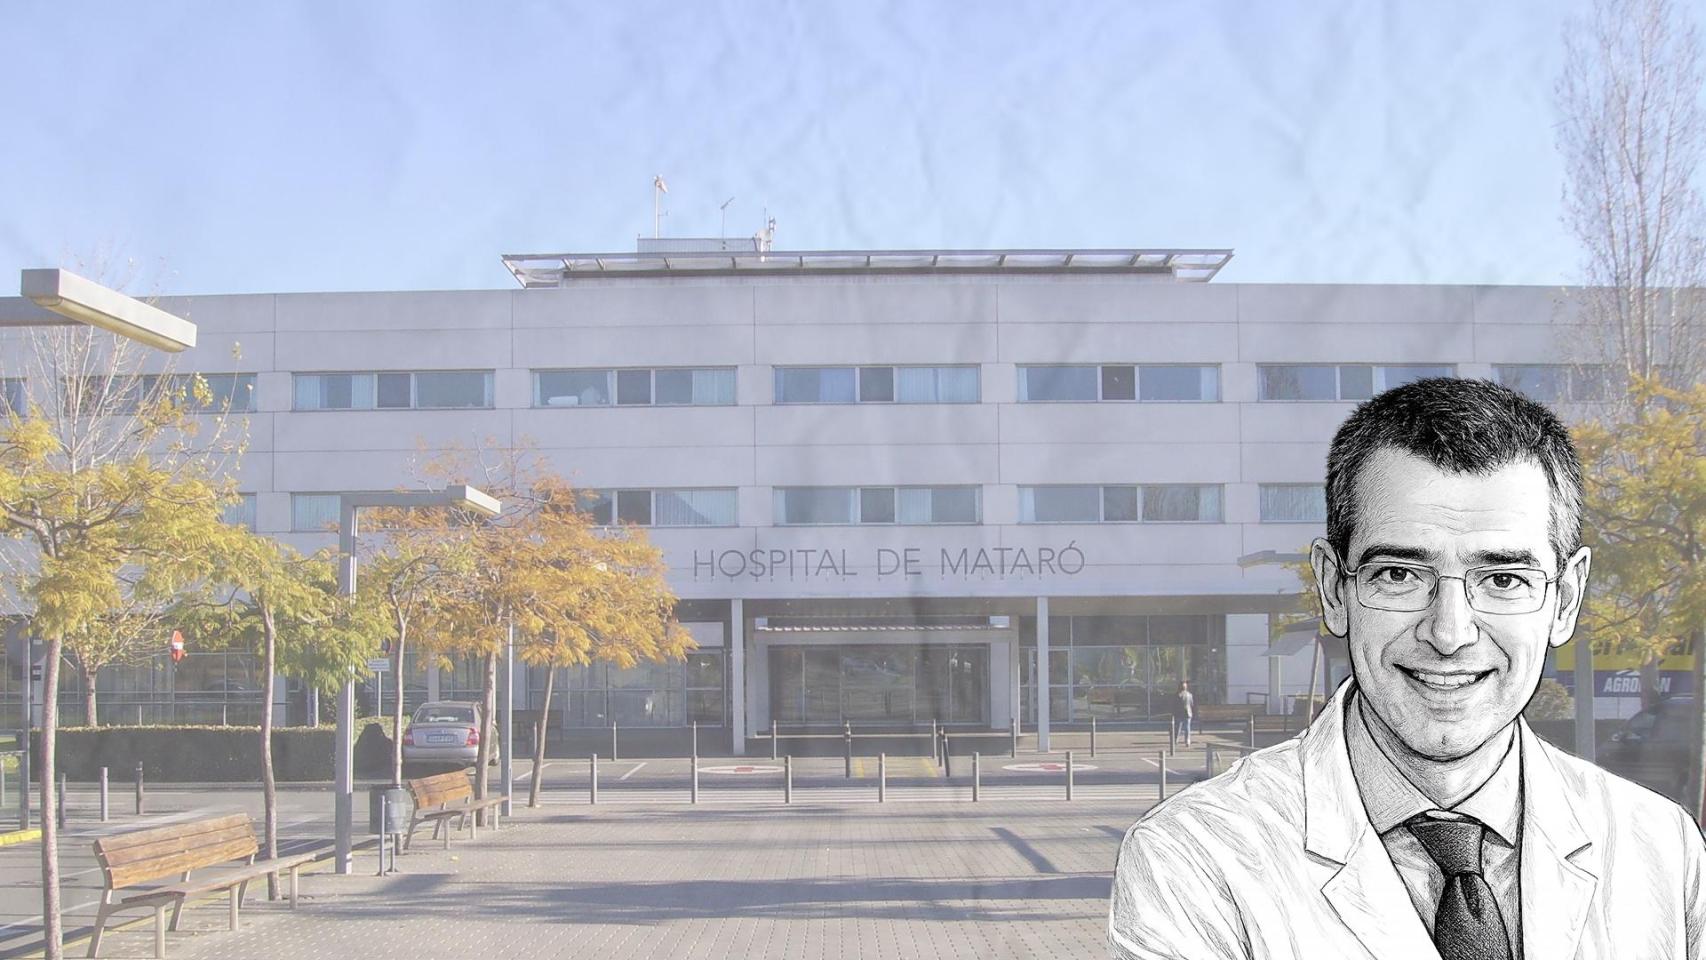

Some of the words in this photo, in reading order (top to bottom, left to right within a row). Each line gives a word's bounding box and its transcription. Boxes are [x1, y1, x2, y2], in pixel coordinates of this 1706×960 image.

[694, 549, 857, 577] HOSPITAL
[877, 548, 922, 575] DE
[941, 540, 1085, 575] MATARÓ
[1603, 677, 1672, 693] AGRON
